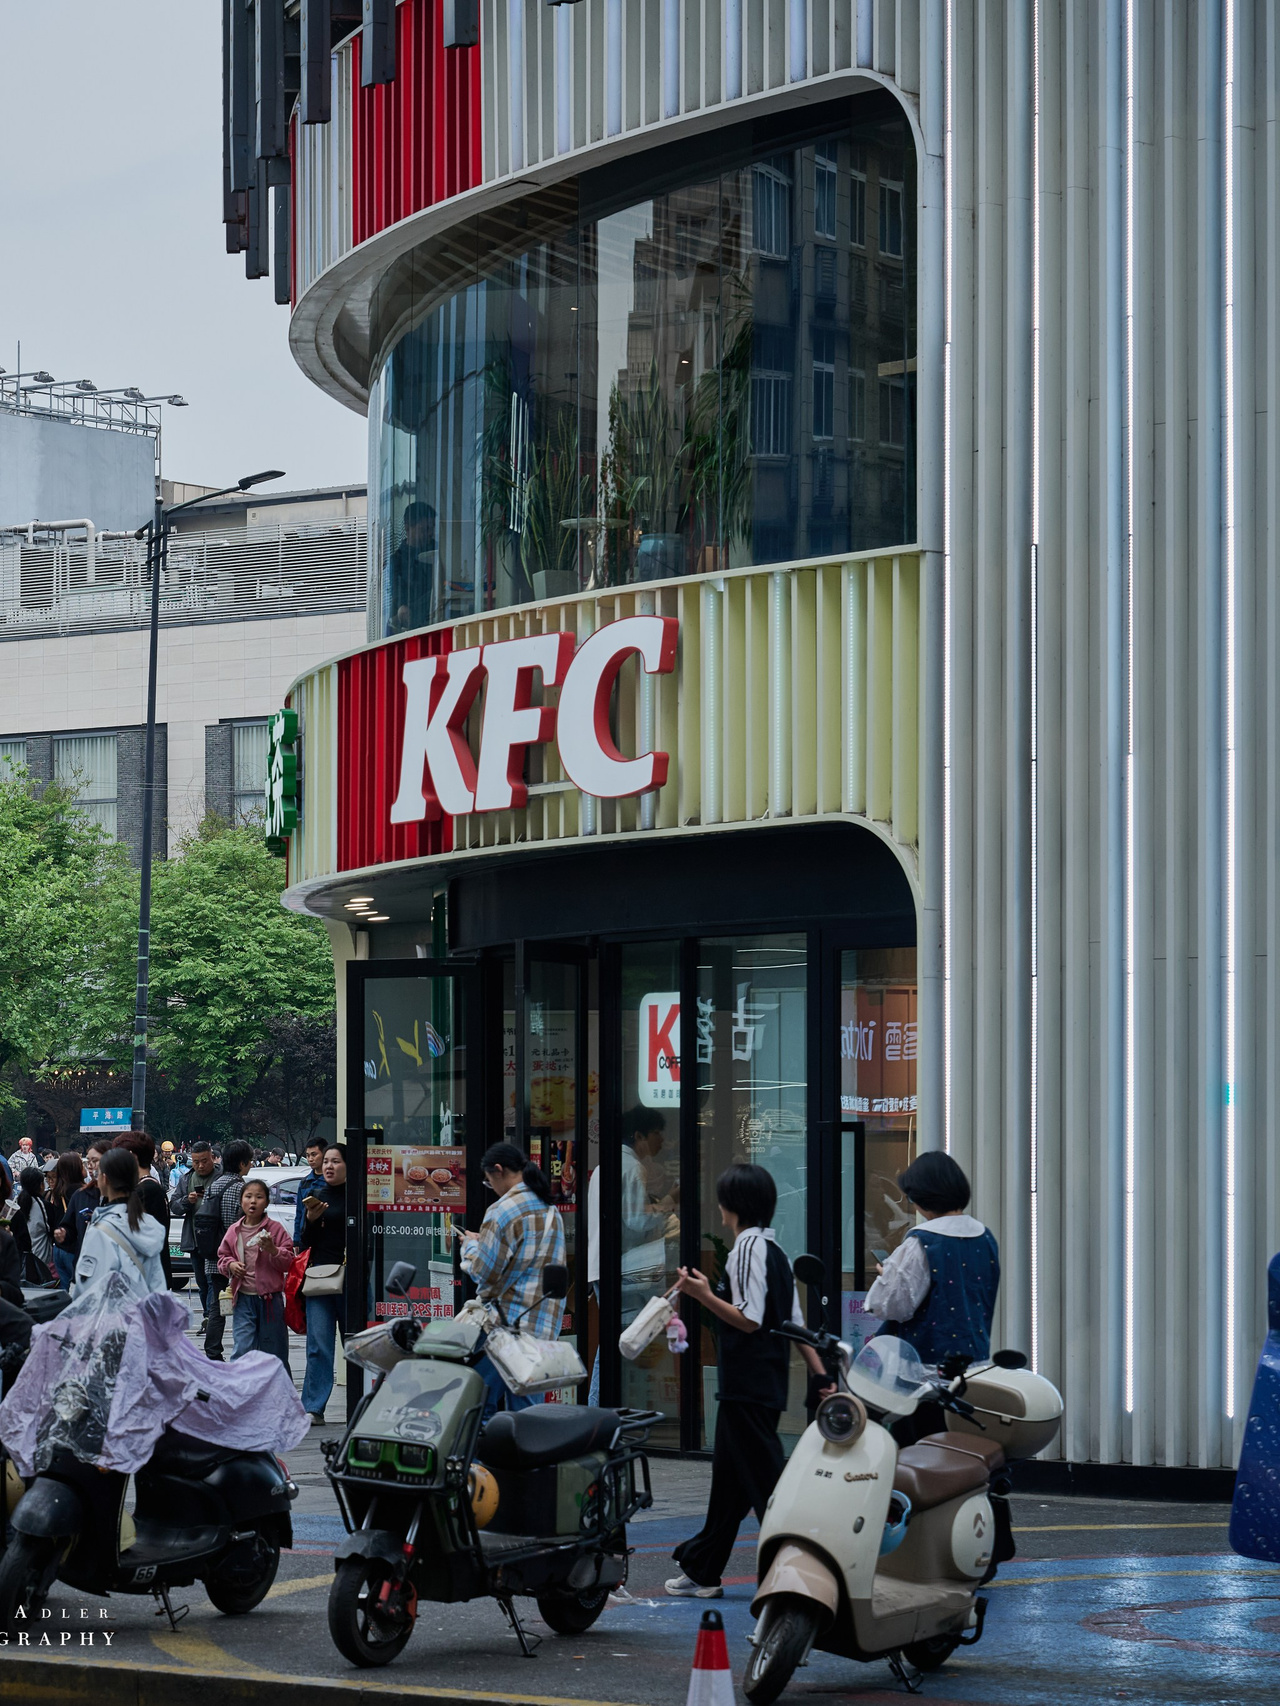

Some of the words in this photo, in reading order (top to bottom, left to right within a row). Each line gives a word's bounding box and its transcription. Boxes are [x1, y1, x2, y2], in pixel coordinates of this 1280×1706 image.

[389, 614, 680, 826] KFC
[92, 1110, 124, 1120] 平海路
[136, 1566, 155, 1580] 66
